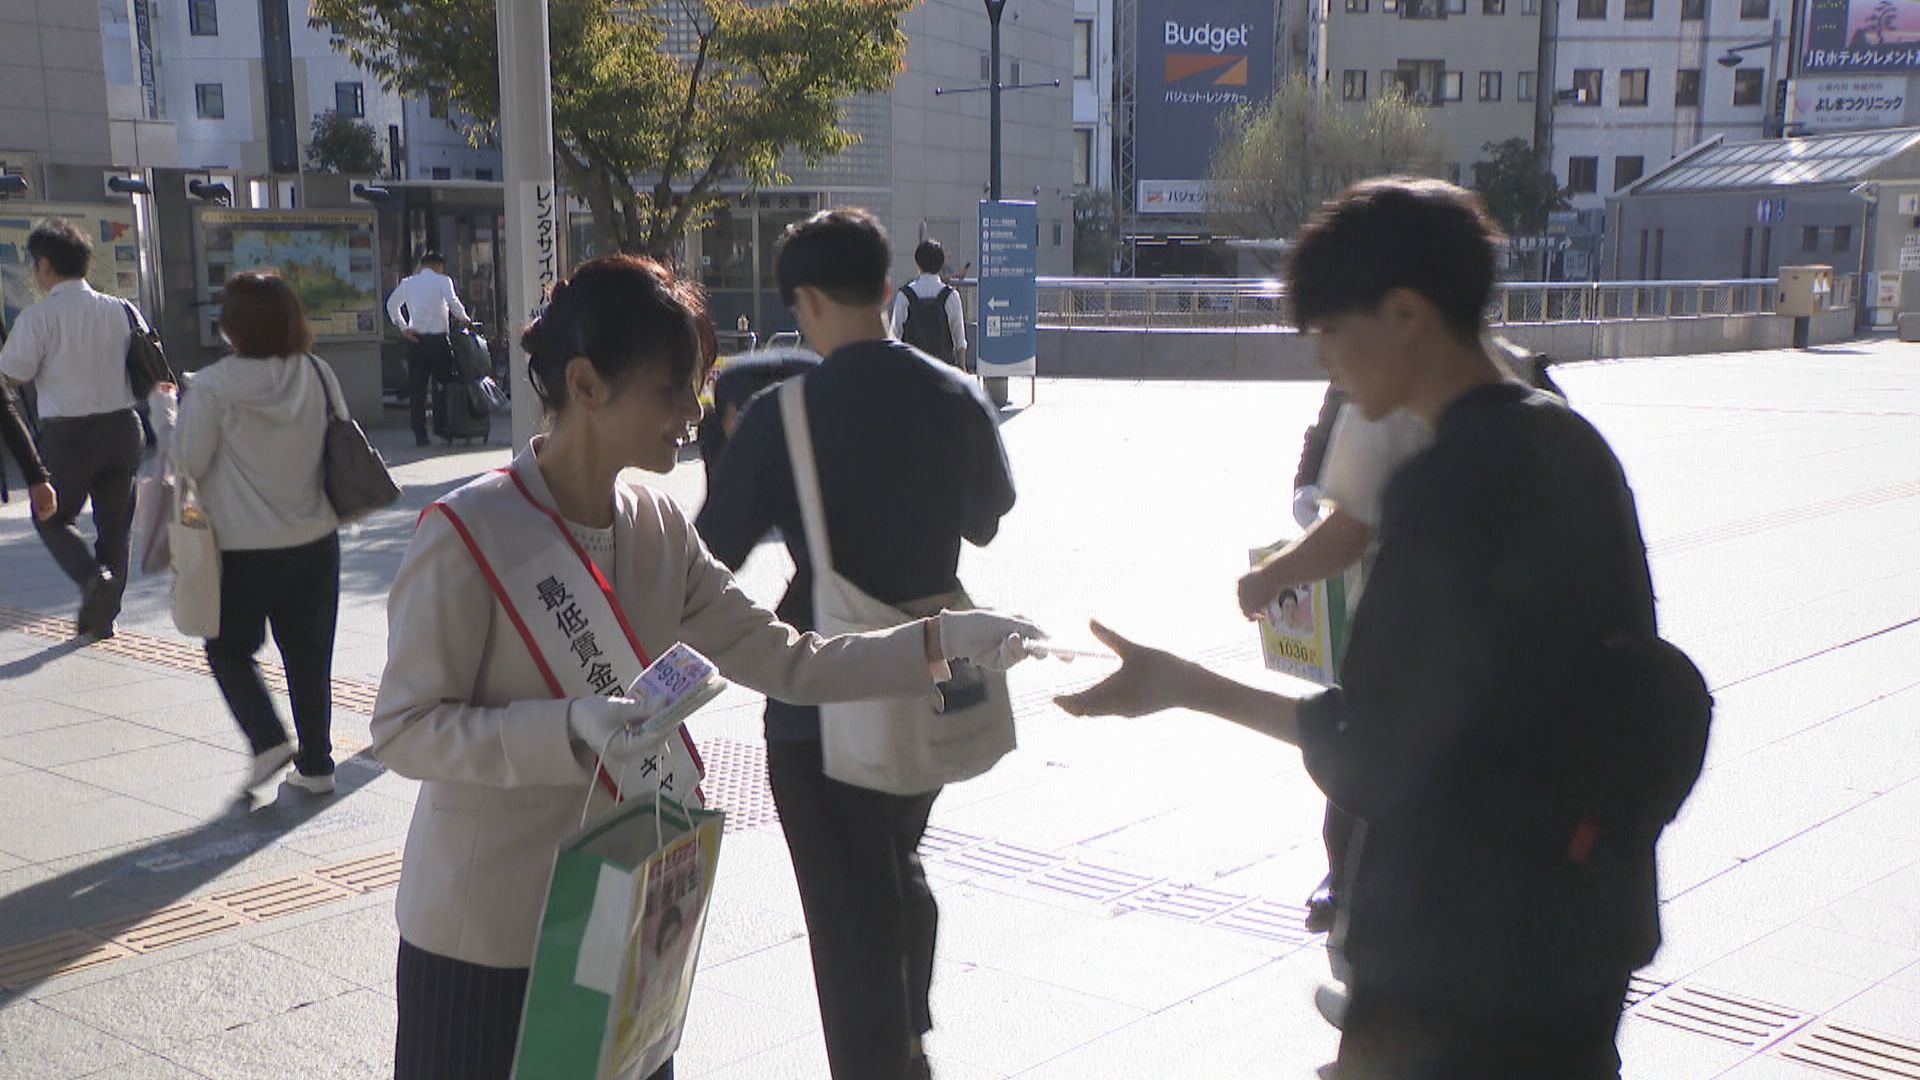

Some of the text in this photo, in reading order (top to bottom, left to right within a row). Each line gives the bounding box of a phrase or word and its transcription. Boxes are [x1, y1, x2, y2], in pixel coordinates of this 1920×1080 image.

[1165, 21, 1247, 52] Budget
[1815, 96, 1903, 111] よしまつクリニック
